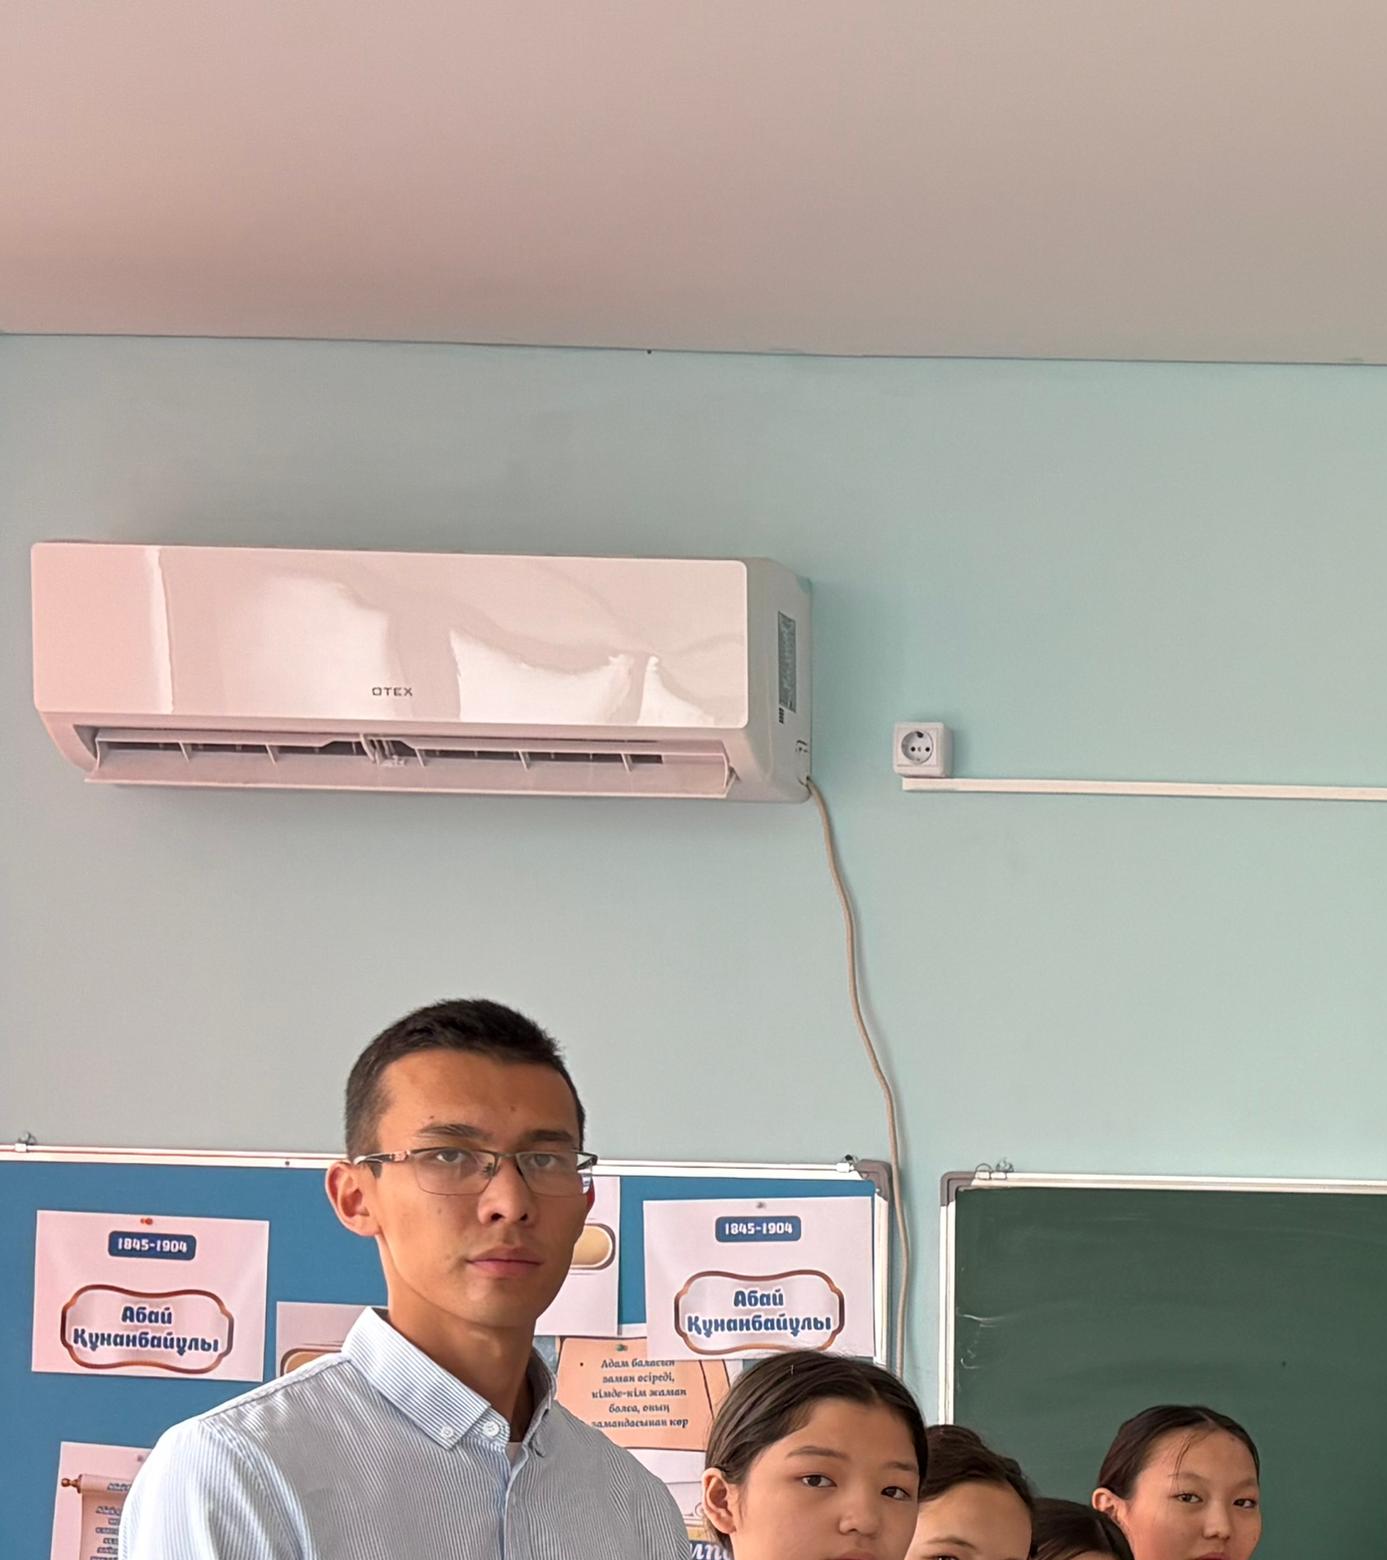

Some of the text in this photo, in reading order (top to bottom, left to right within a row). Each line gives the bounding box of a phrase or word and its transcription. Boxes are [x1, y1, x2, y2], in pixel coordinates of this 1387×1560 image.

[371, 686, 413, 697] OTEX
[724, 1221, 794, 1236] 1845-1904
[117, 1237, 188, 1253] 1845-1904
[733, 1289, 784, 1308] Абай
[121, 1306, 172, 1324] Абай
[686, 1314, 832, 1338] Құнанбайұлы
[72, 1328, 219, 1356] Құнанбайұлы
[601, 1359, 629, 1369] Адам
